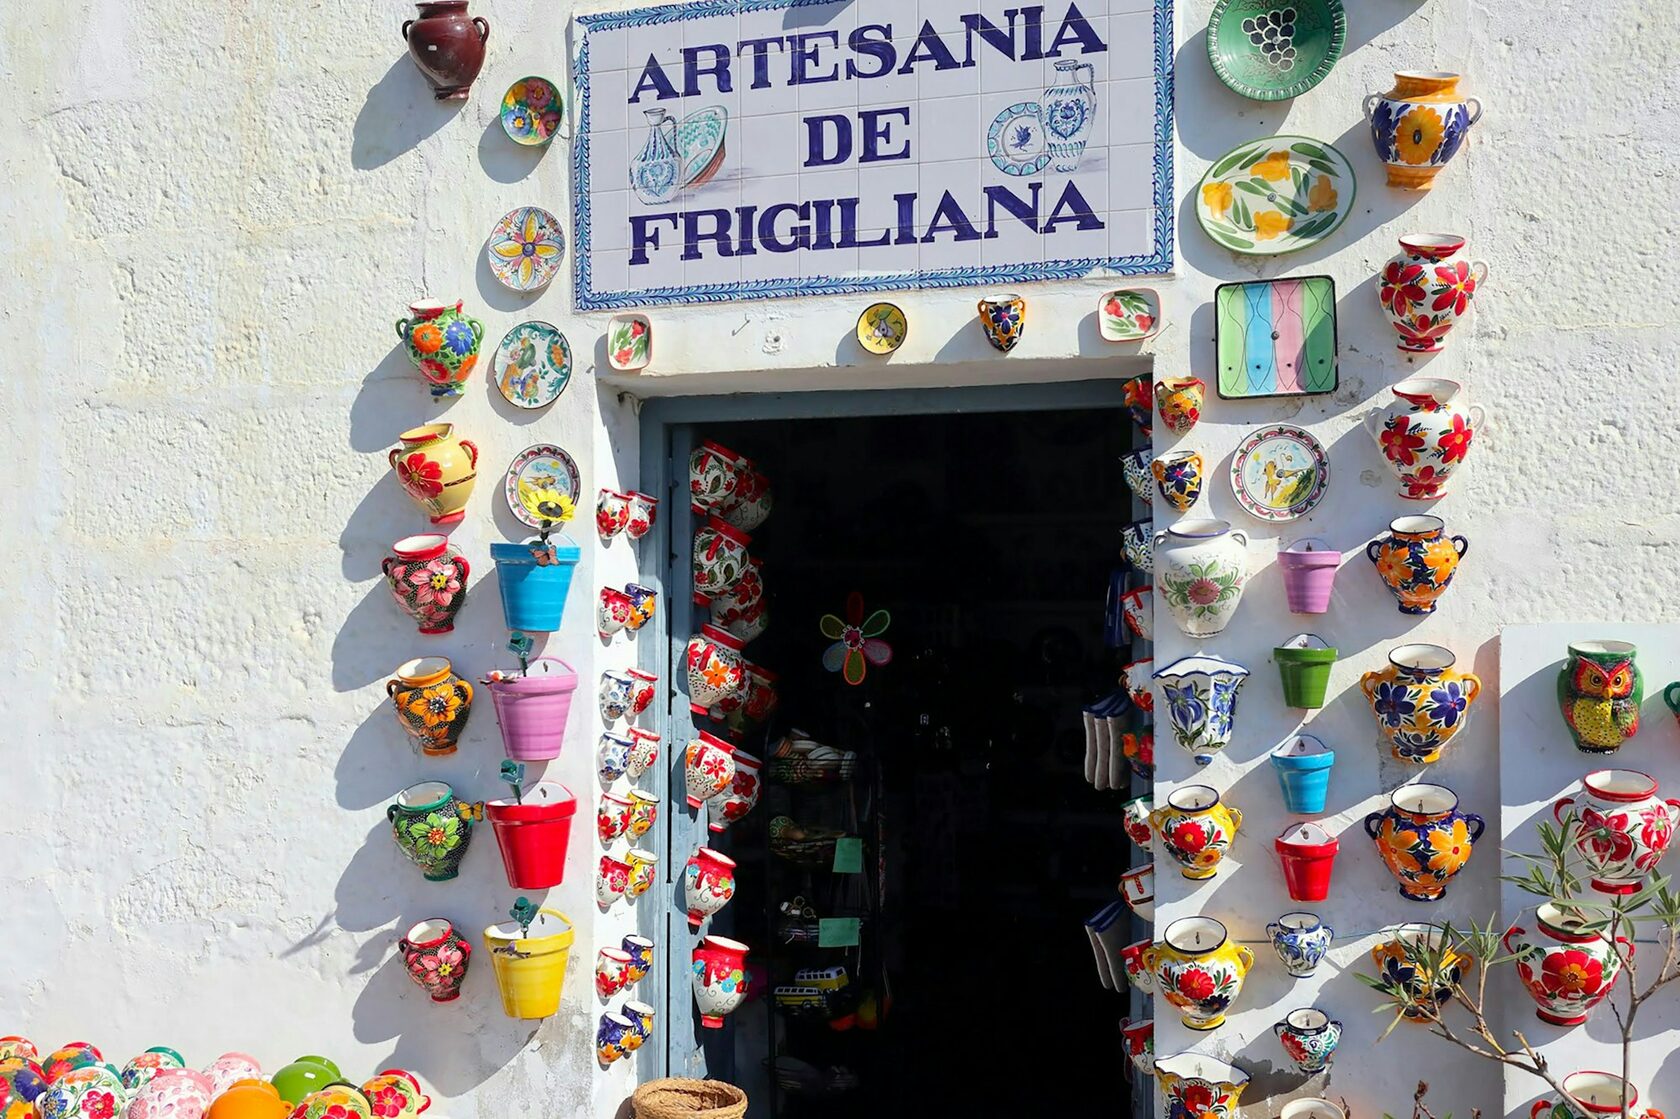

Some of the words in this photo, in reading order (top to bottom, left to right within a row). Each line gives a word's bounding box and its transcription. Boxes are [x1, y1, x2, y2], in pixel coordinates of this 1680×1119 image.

[628, 2, 1107, 104] ARTESANIA
[803, 107, 911, 168] DE
[628, 179, 1105, 265] FRIGILIANA
